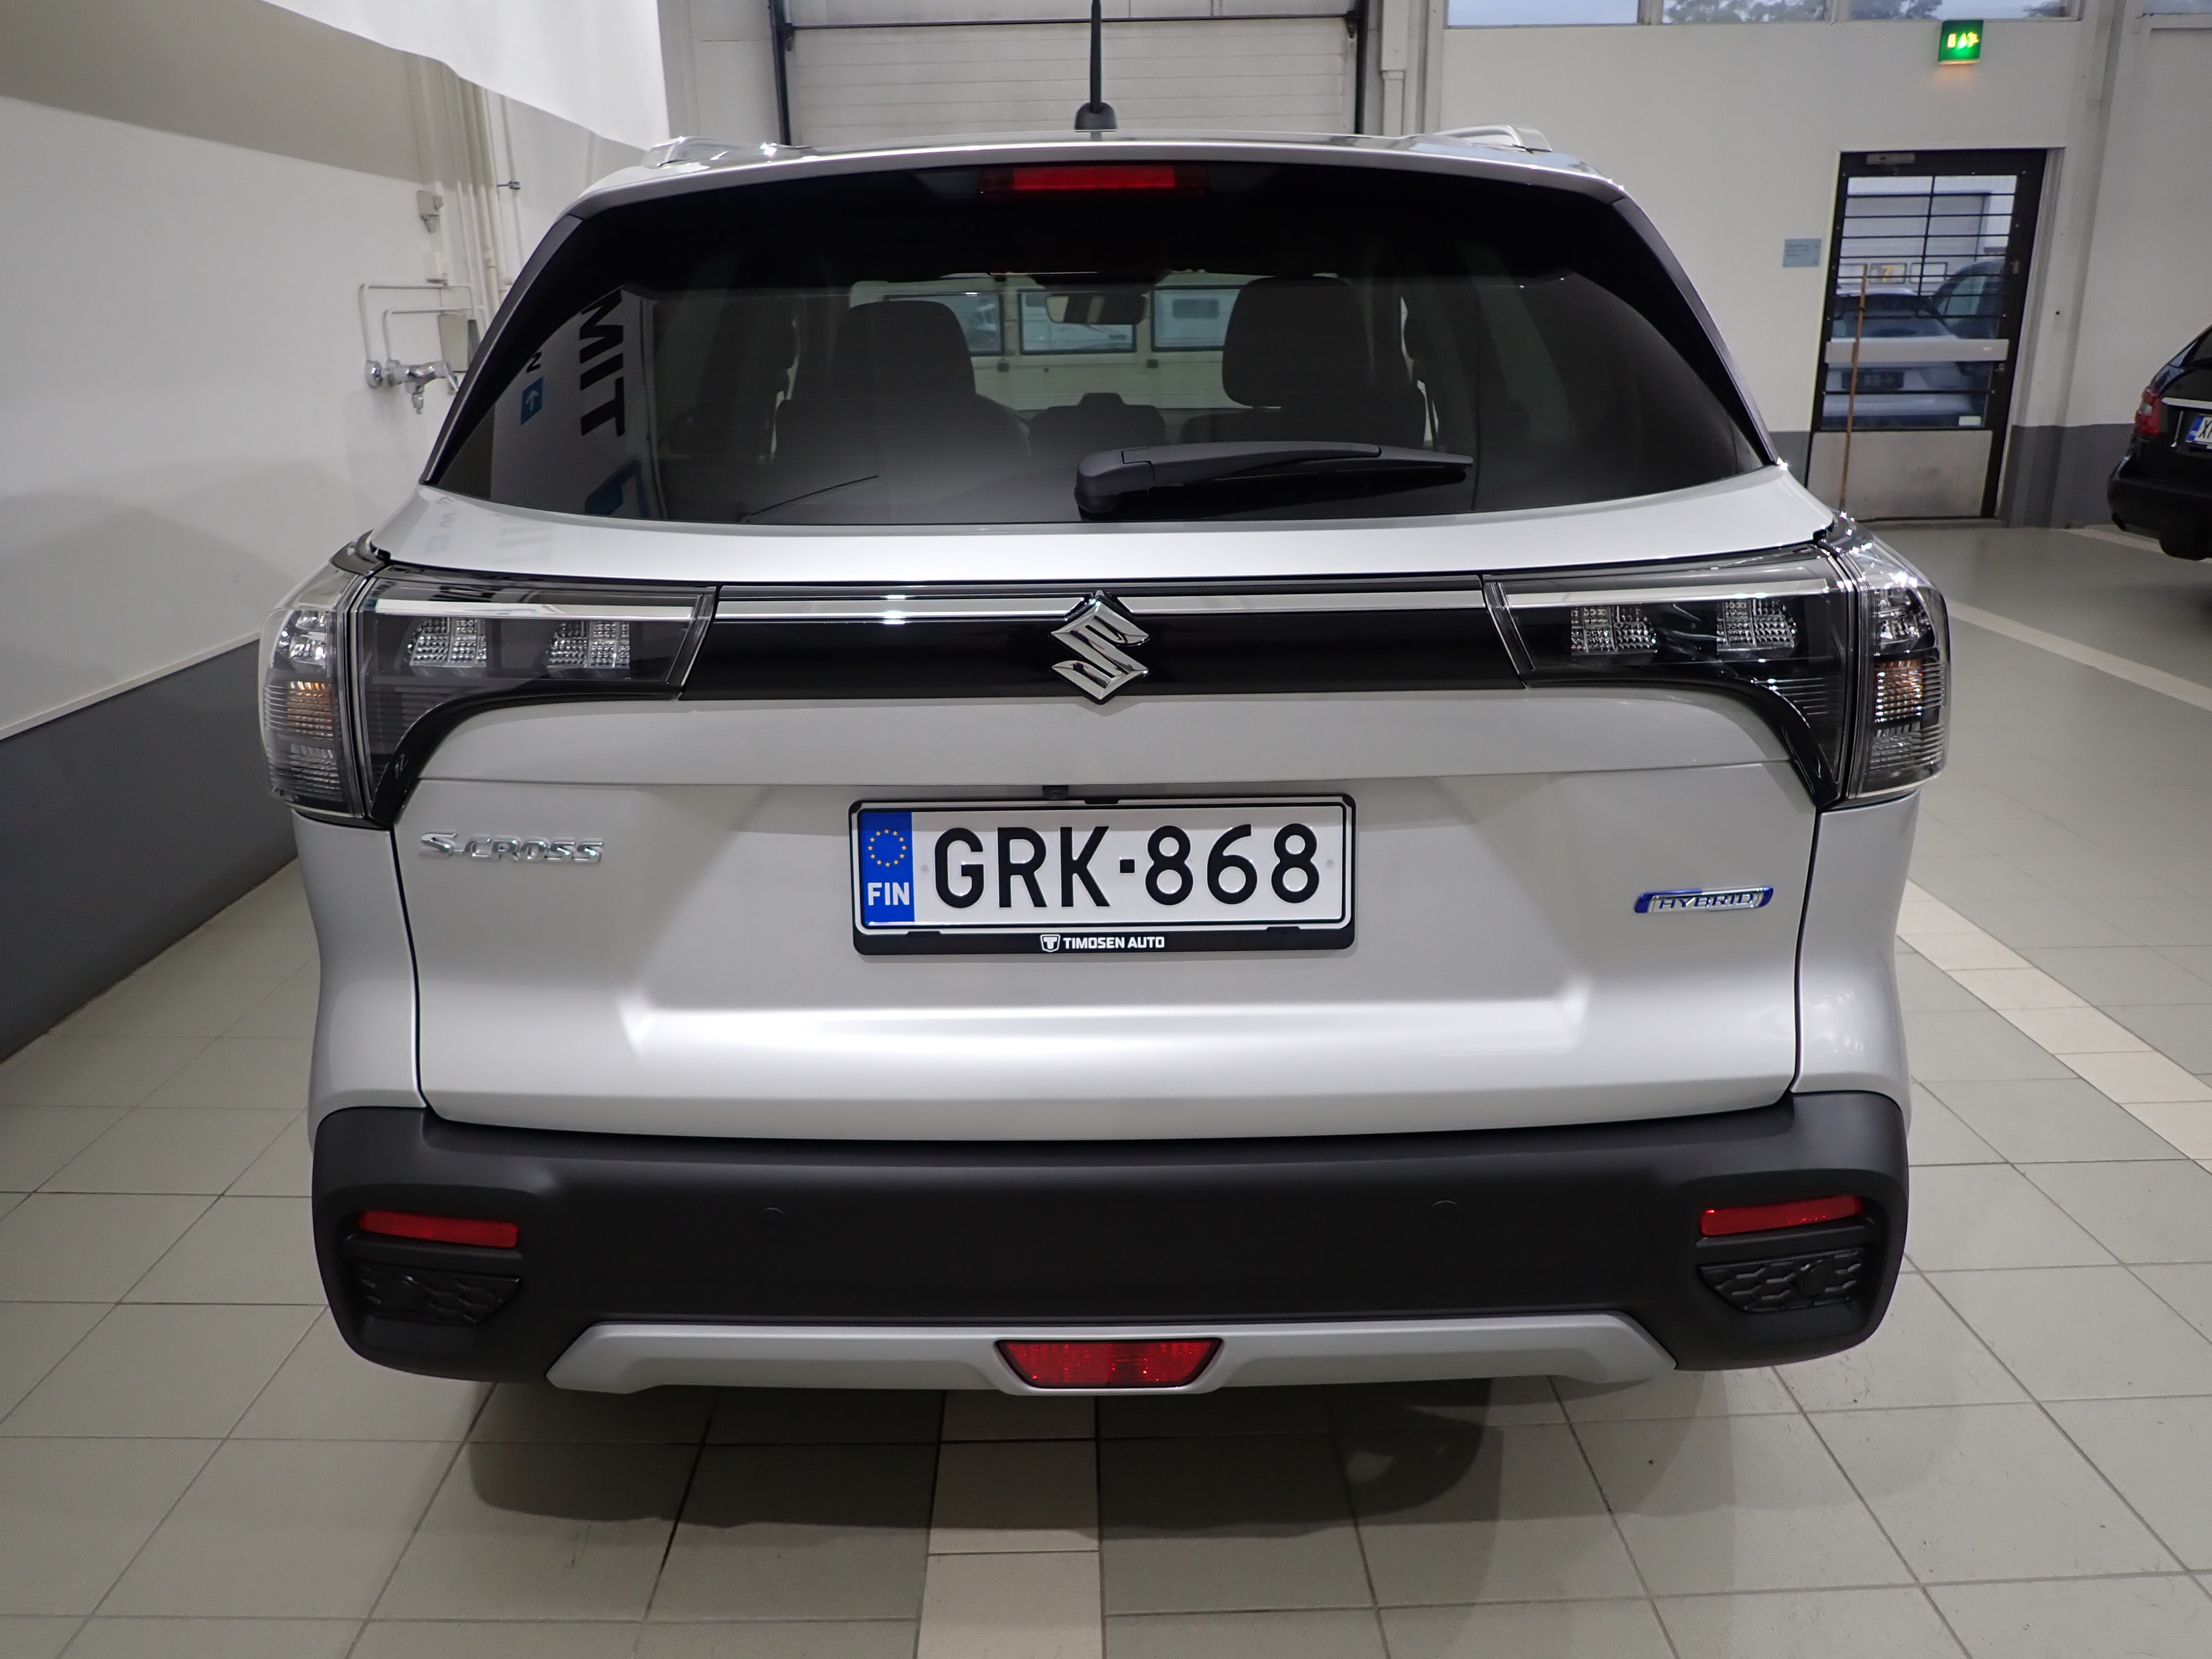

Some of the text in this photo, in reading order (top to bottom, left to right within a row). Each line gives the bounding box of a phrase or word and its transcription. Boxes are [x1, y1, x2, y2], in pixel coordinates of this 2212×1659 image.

[933, 822, 1321, 909] GRK-868
[867, 881, 911, 906] FIN
[1658, 892, 1755, 910] HYBRID
[1062, 936, 1125, 950] TIMOSEN
[1127, 936, 1165, 949] AUTO
